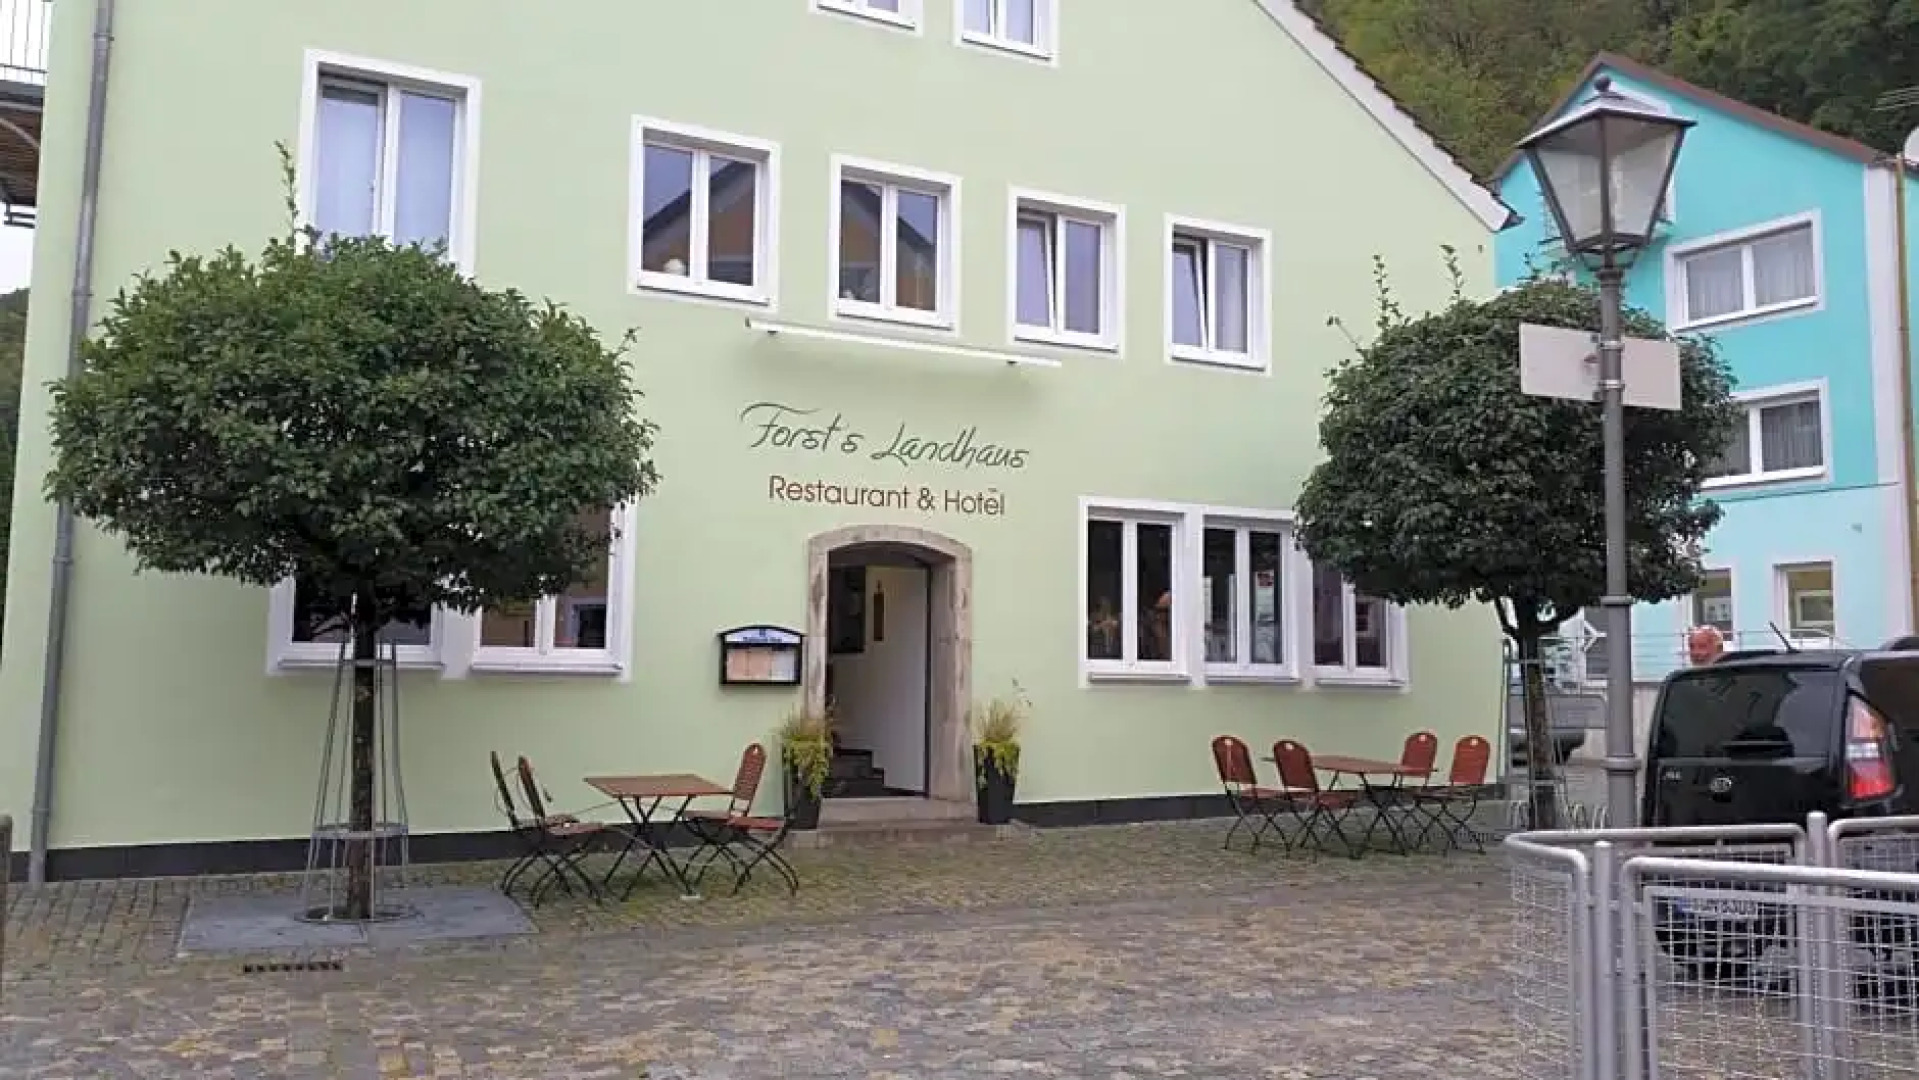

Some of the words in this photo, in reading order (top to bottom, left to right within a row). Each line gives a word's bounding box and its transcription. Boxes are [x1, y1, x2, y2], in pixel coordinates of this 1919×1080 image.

[740, 402, 864, 453] Forst's
[870, 422, 1029, 469] Landhaus
[769, 475, 910, 509] Restaurant
[918, 488, 935, 511] &
[944, 491, 1006, 515] Hotel
